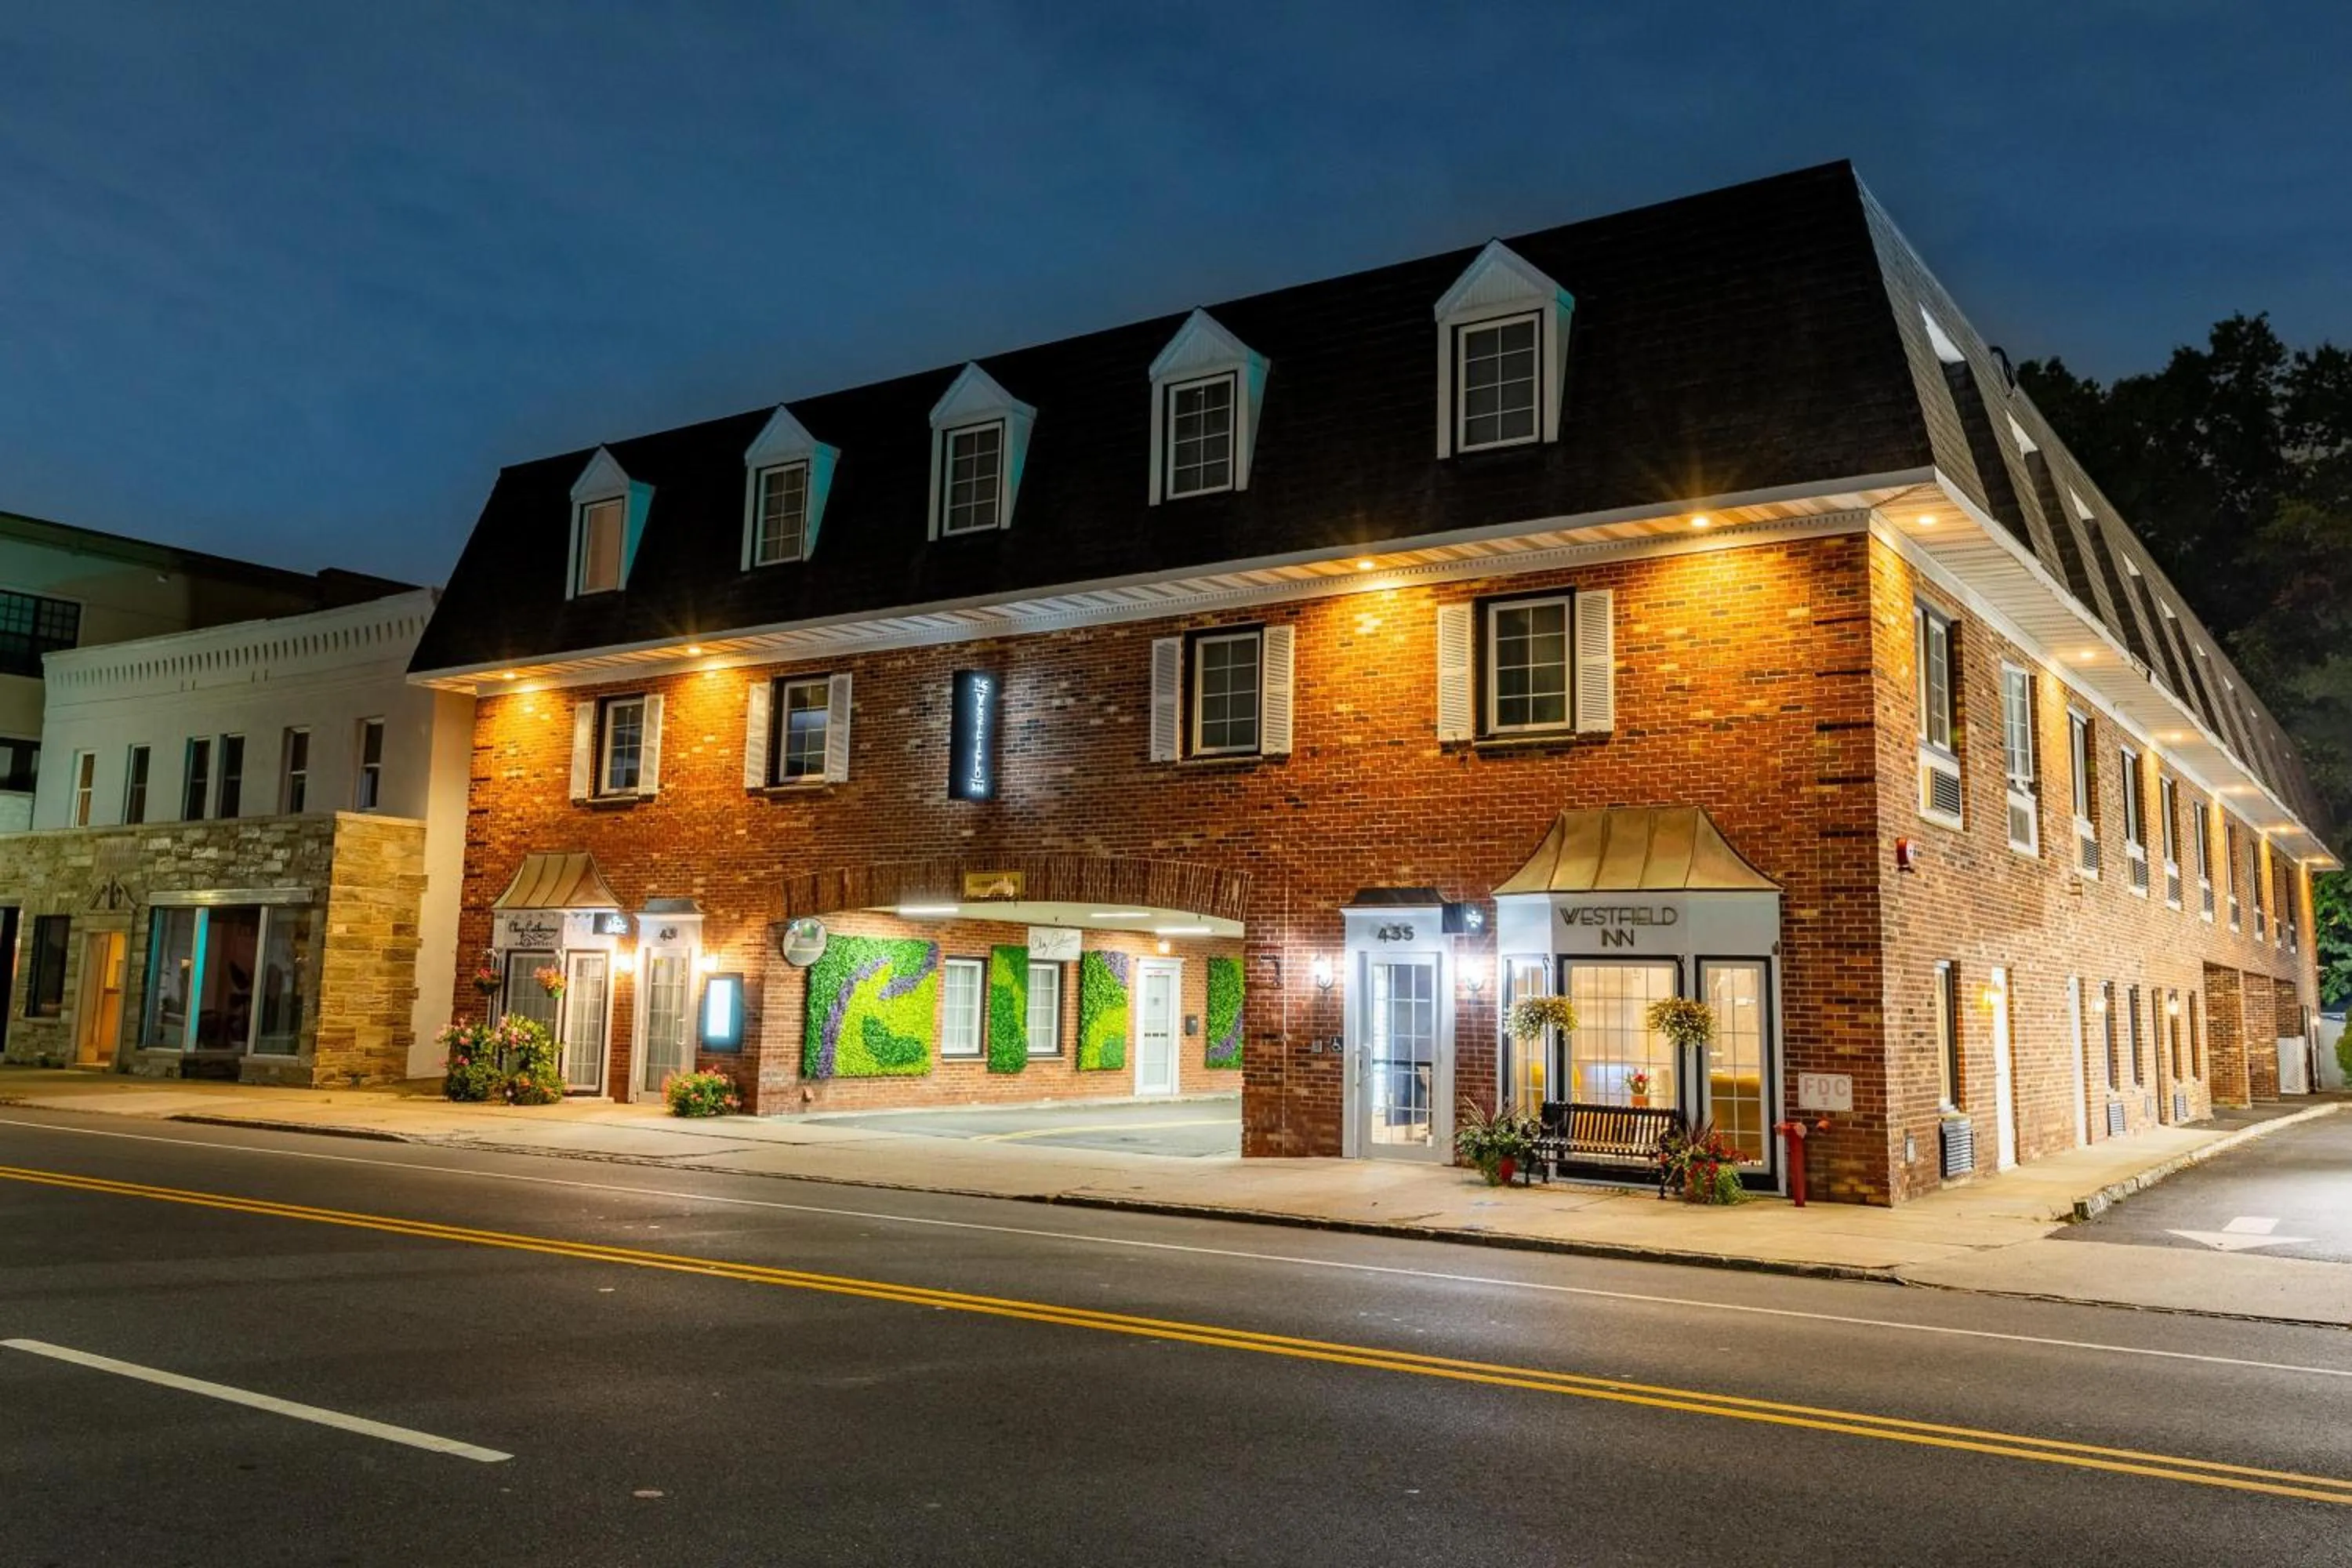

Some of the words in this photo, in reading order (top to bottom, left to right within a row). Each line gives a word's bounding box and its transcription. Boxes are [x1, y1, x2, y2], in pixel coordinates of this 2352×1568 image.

[1559, 906, 1679, 926] WESTFIELD
[1377, 925, 1415, 942] 435
[1601, 928, 1635, 947] INN
[1804, 1077, 1848, 1097] FDC
